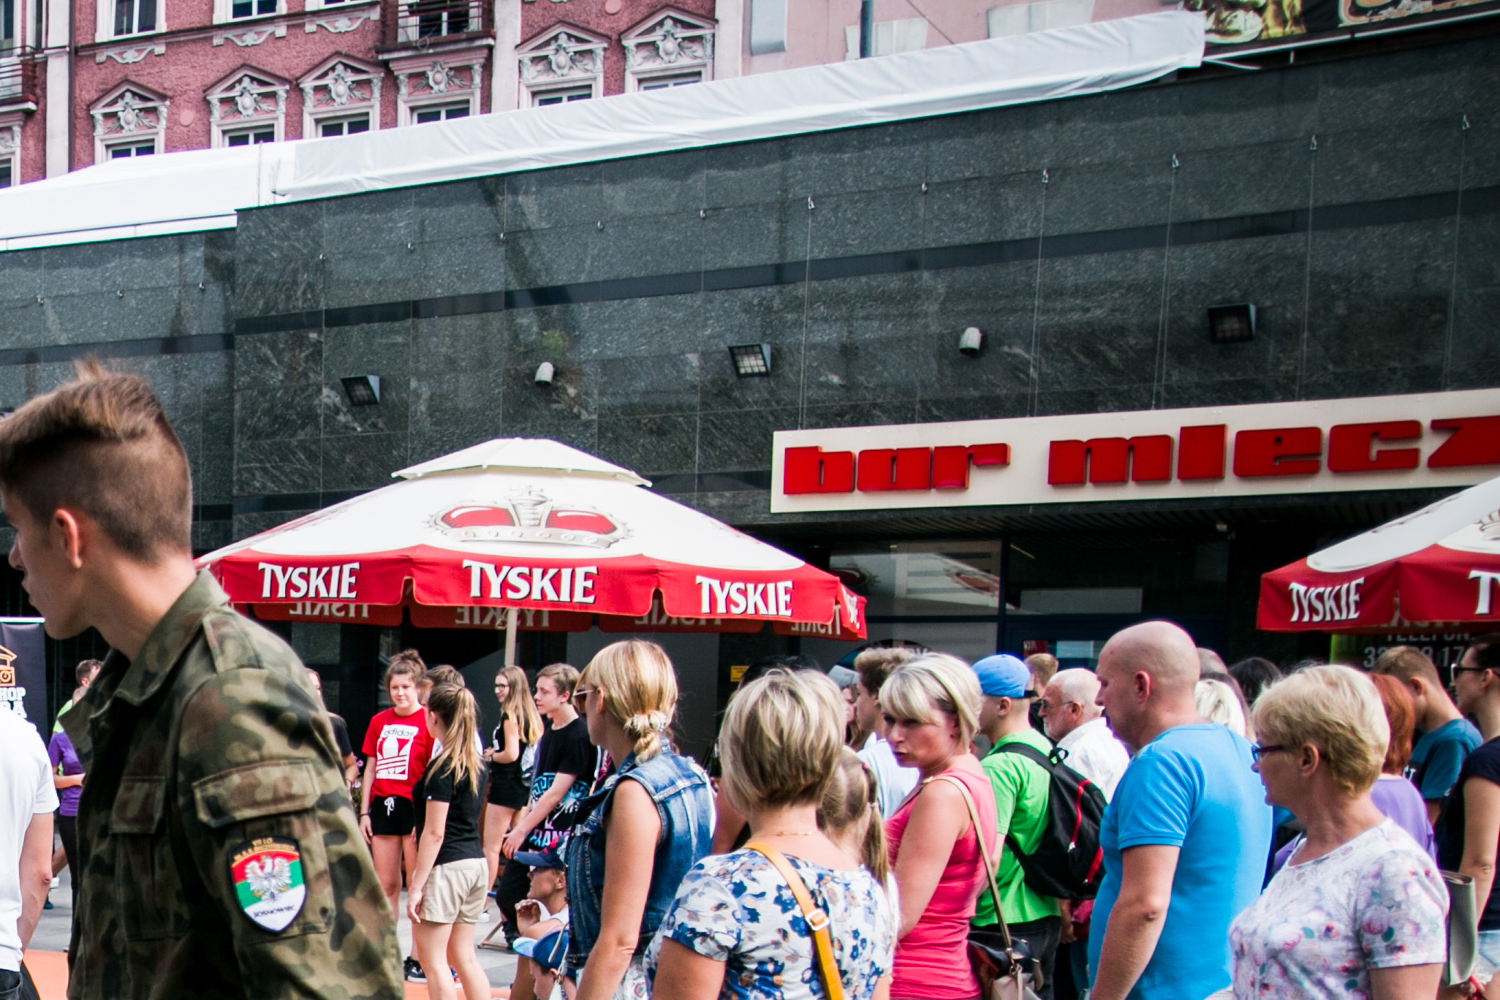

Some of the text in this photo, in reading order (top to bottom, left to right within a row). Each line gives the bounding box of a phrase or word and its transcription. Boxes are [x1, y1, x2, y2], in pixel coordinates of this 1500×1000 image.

[783, 415, 1500, 496] bar mlecz
[257, 562, 361, 600] TYSKIE
[462, 559, 598, 605] TYSKIE
[695, 575, 794, 618] TYSKIE
[1288, 577, 1365, 623] TYSKIE
